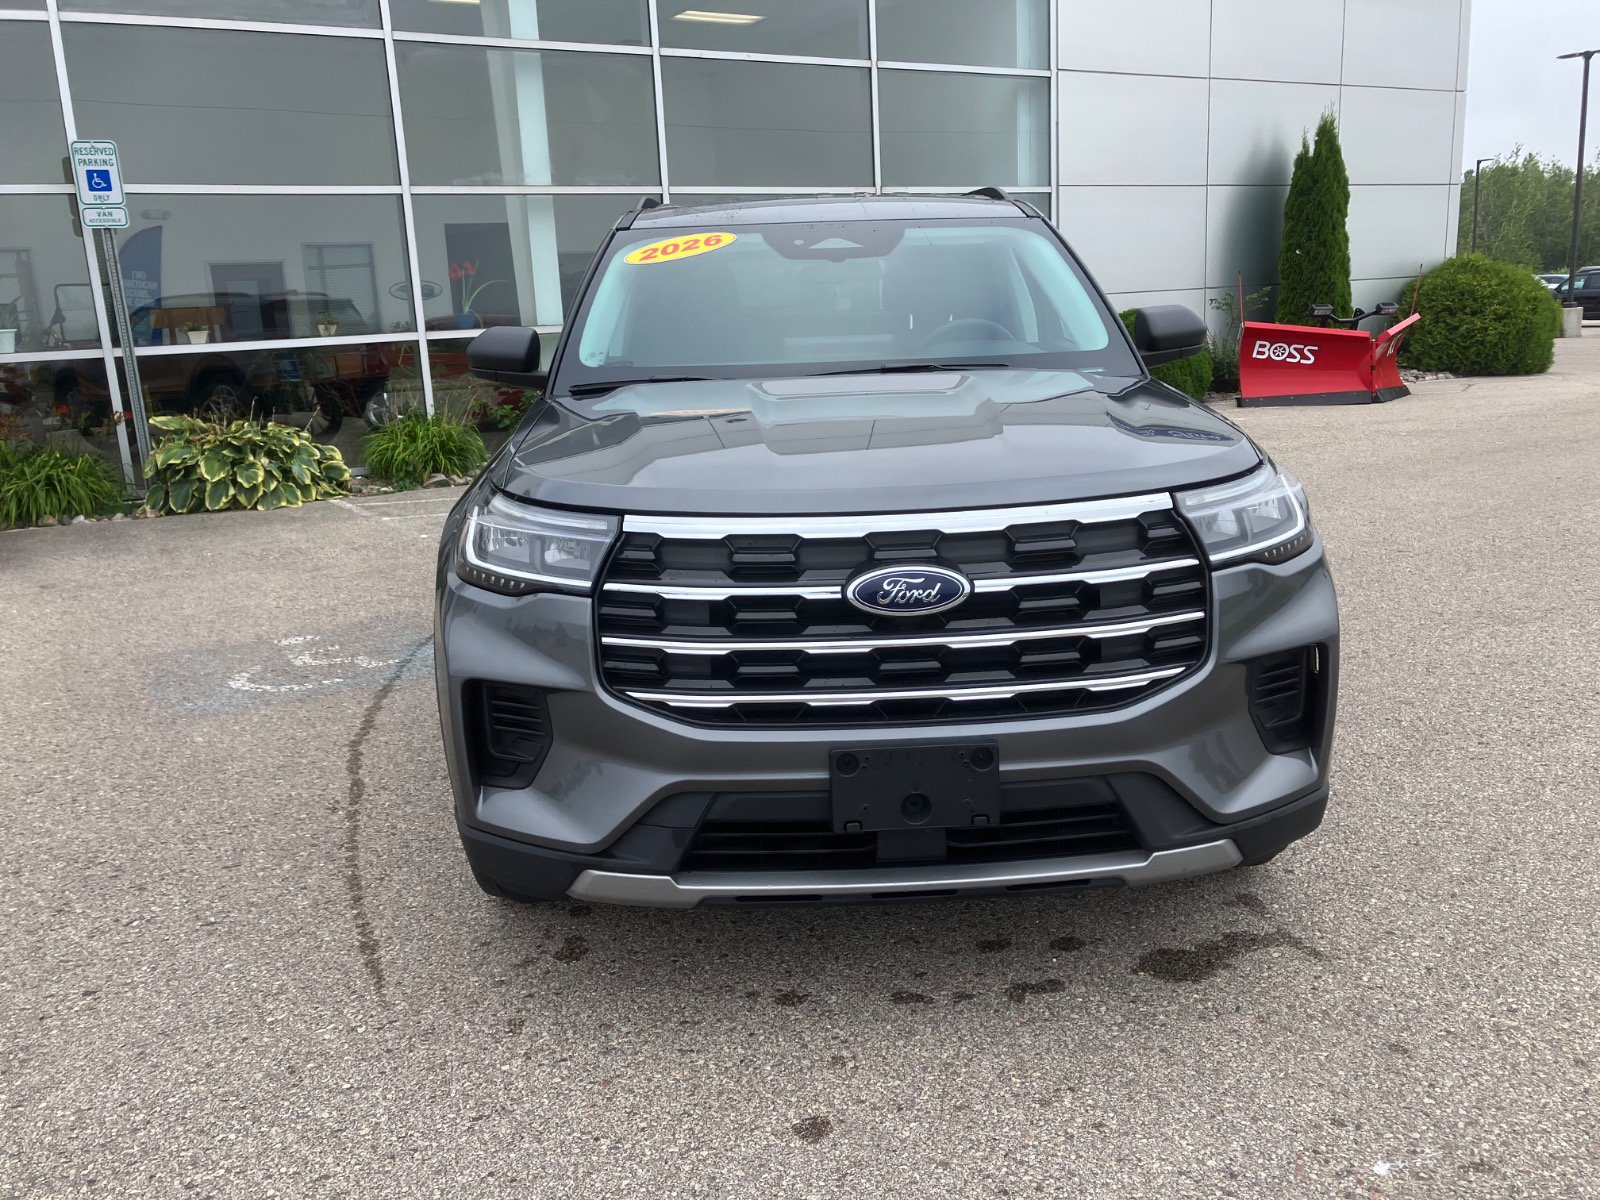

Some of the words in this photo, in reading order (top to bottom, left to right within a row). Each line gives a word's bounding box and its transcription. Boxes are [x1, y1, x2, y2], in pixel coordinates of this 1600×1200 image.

[74, 147, 114, 156] RESERVED
[78, 158, 114, 166] PARKING
[639, 235, 723, 262] 2026
[1252, 340, 1319, 365] BOSS
[876, 577, 942, 605] Ford
